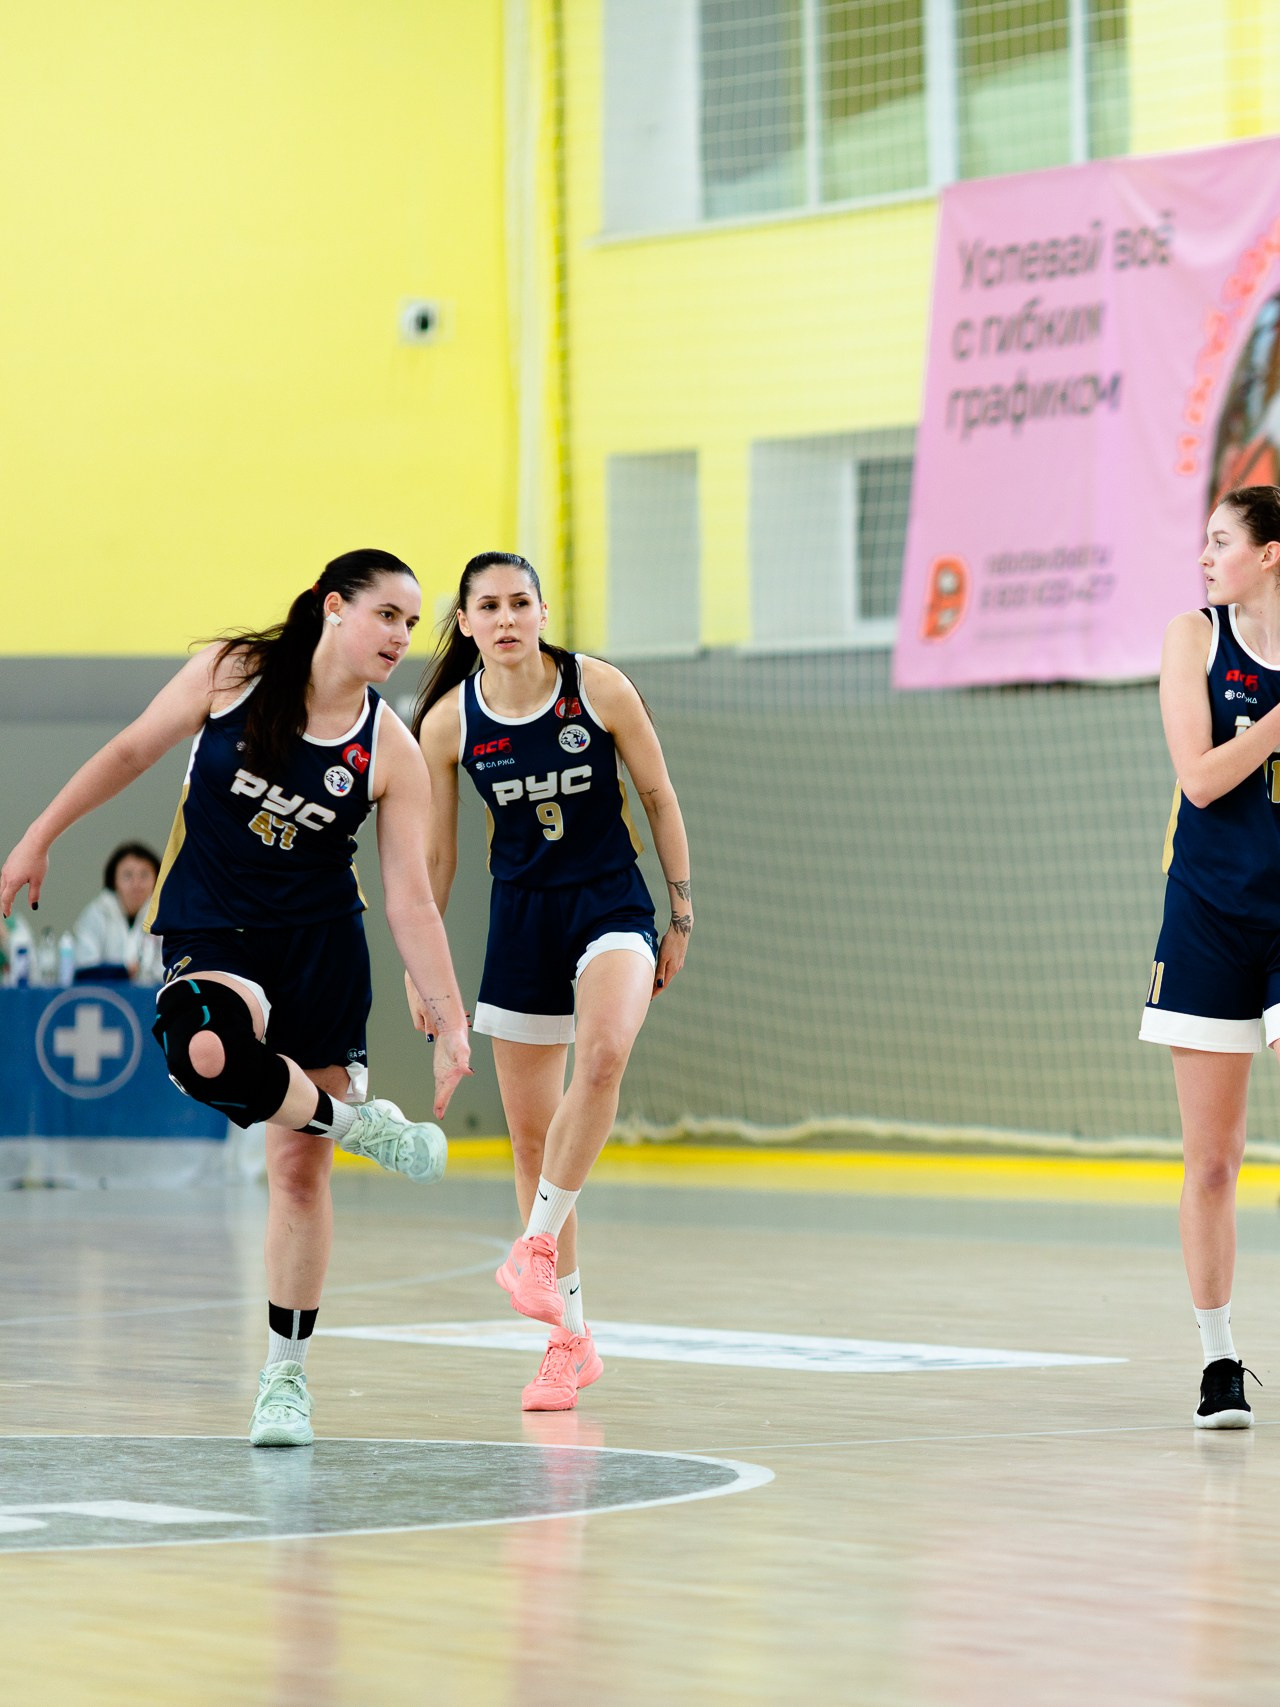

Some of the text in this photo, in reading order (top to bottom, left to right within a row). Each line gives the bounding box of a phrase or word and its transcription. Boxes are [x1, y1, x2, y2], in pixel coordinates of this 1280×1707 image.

[957, 210, 1175, 291] Успевай всё
[952, 297, 1105, 361] с гибким
[947, 369, 1123, 441] графиком
[473, 738, 512, 756] АСБ
[486, 758, 515, 769] СЛ РЖД
[230, 768, 336, 831] РУС
[492, 765, 592, 806] РУС
[536, 801, 564, 841] 9
